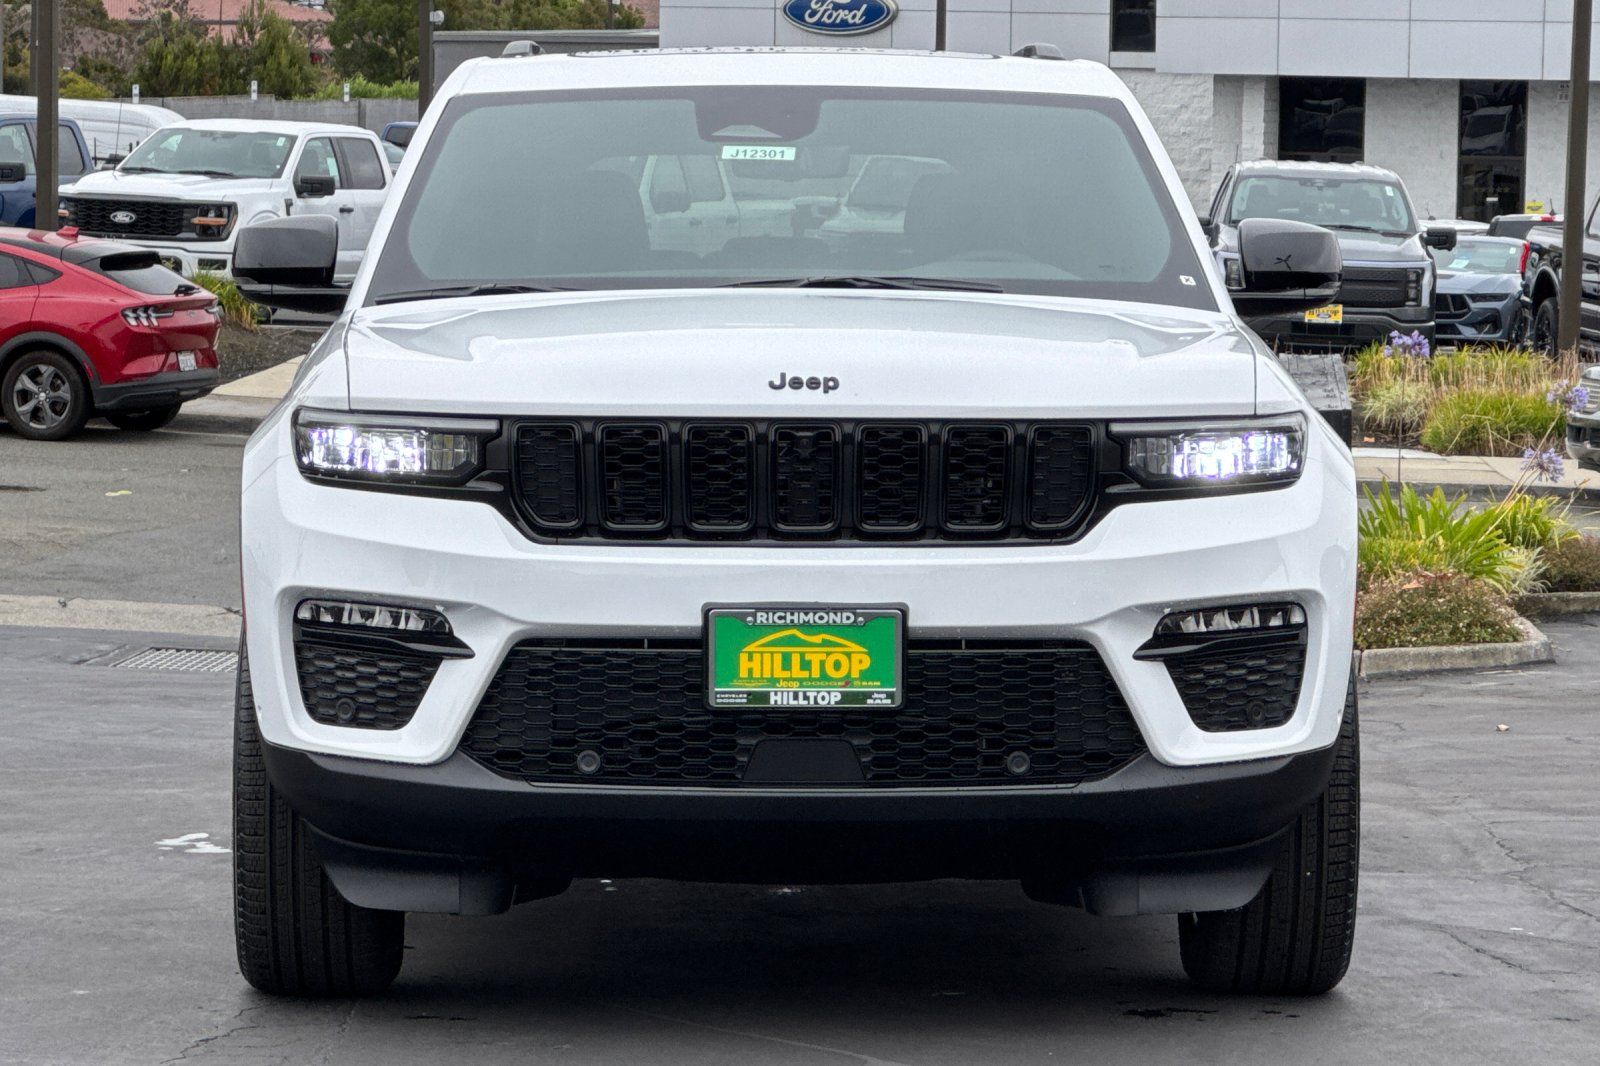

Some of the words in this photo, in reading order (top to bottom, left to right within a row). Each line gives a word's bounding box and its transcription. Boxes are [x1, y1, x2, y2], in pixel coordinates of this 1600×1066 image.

[804, 0, 868, 24] Ford
[730, 149, 786, 159] J12301
[768, 372, 840, 394] Jeep
[756, 611, 855, 625] RICHMOND
[739, 652, 871, 678] HILLTOP
[776, 679, 800, 689] Jeep
[769, 691, 842, 706] HILLTOP
[871, 692, 887, 700] Jeep
